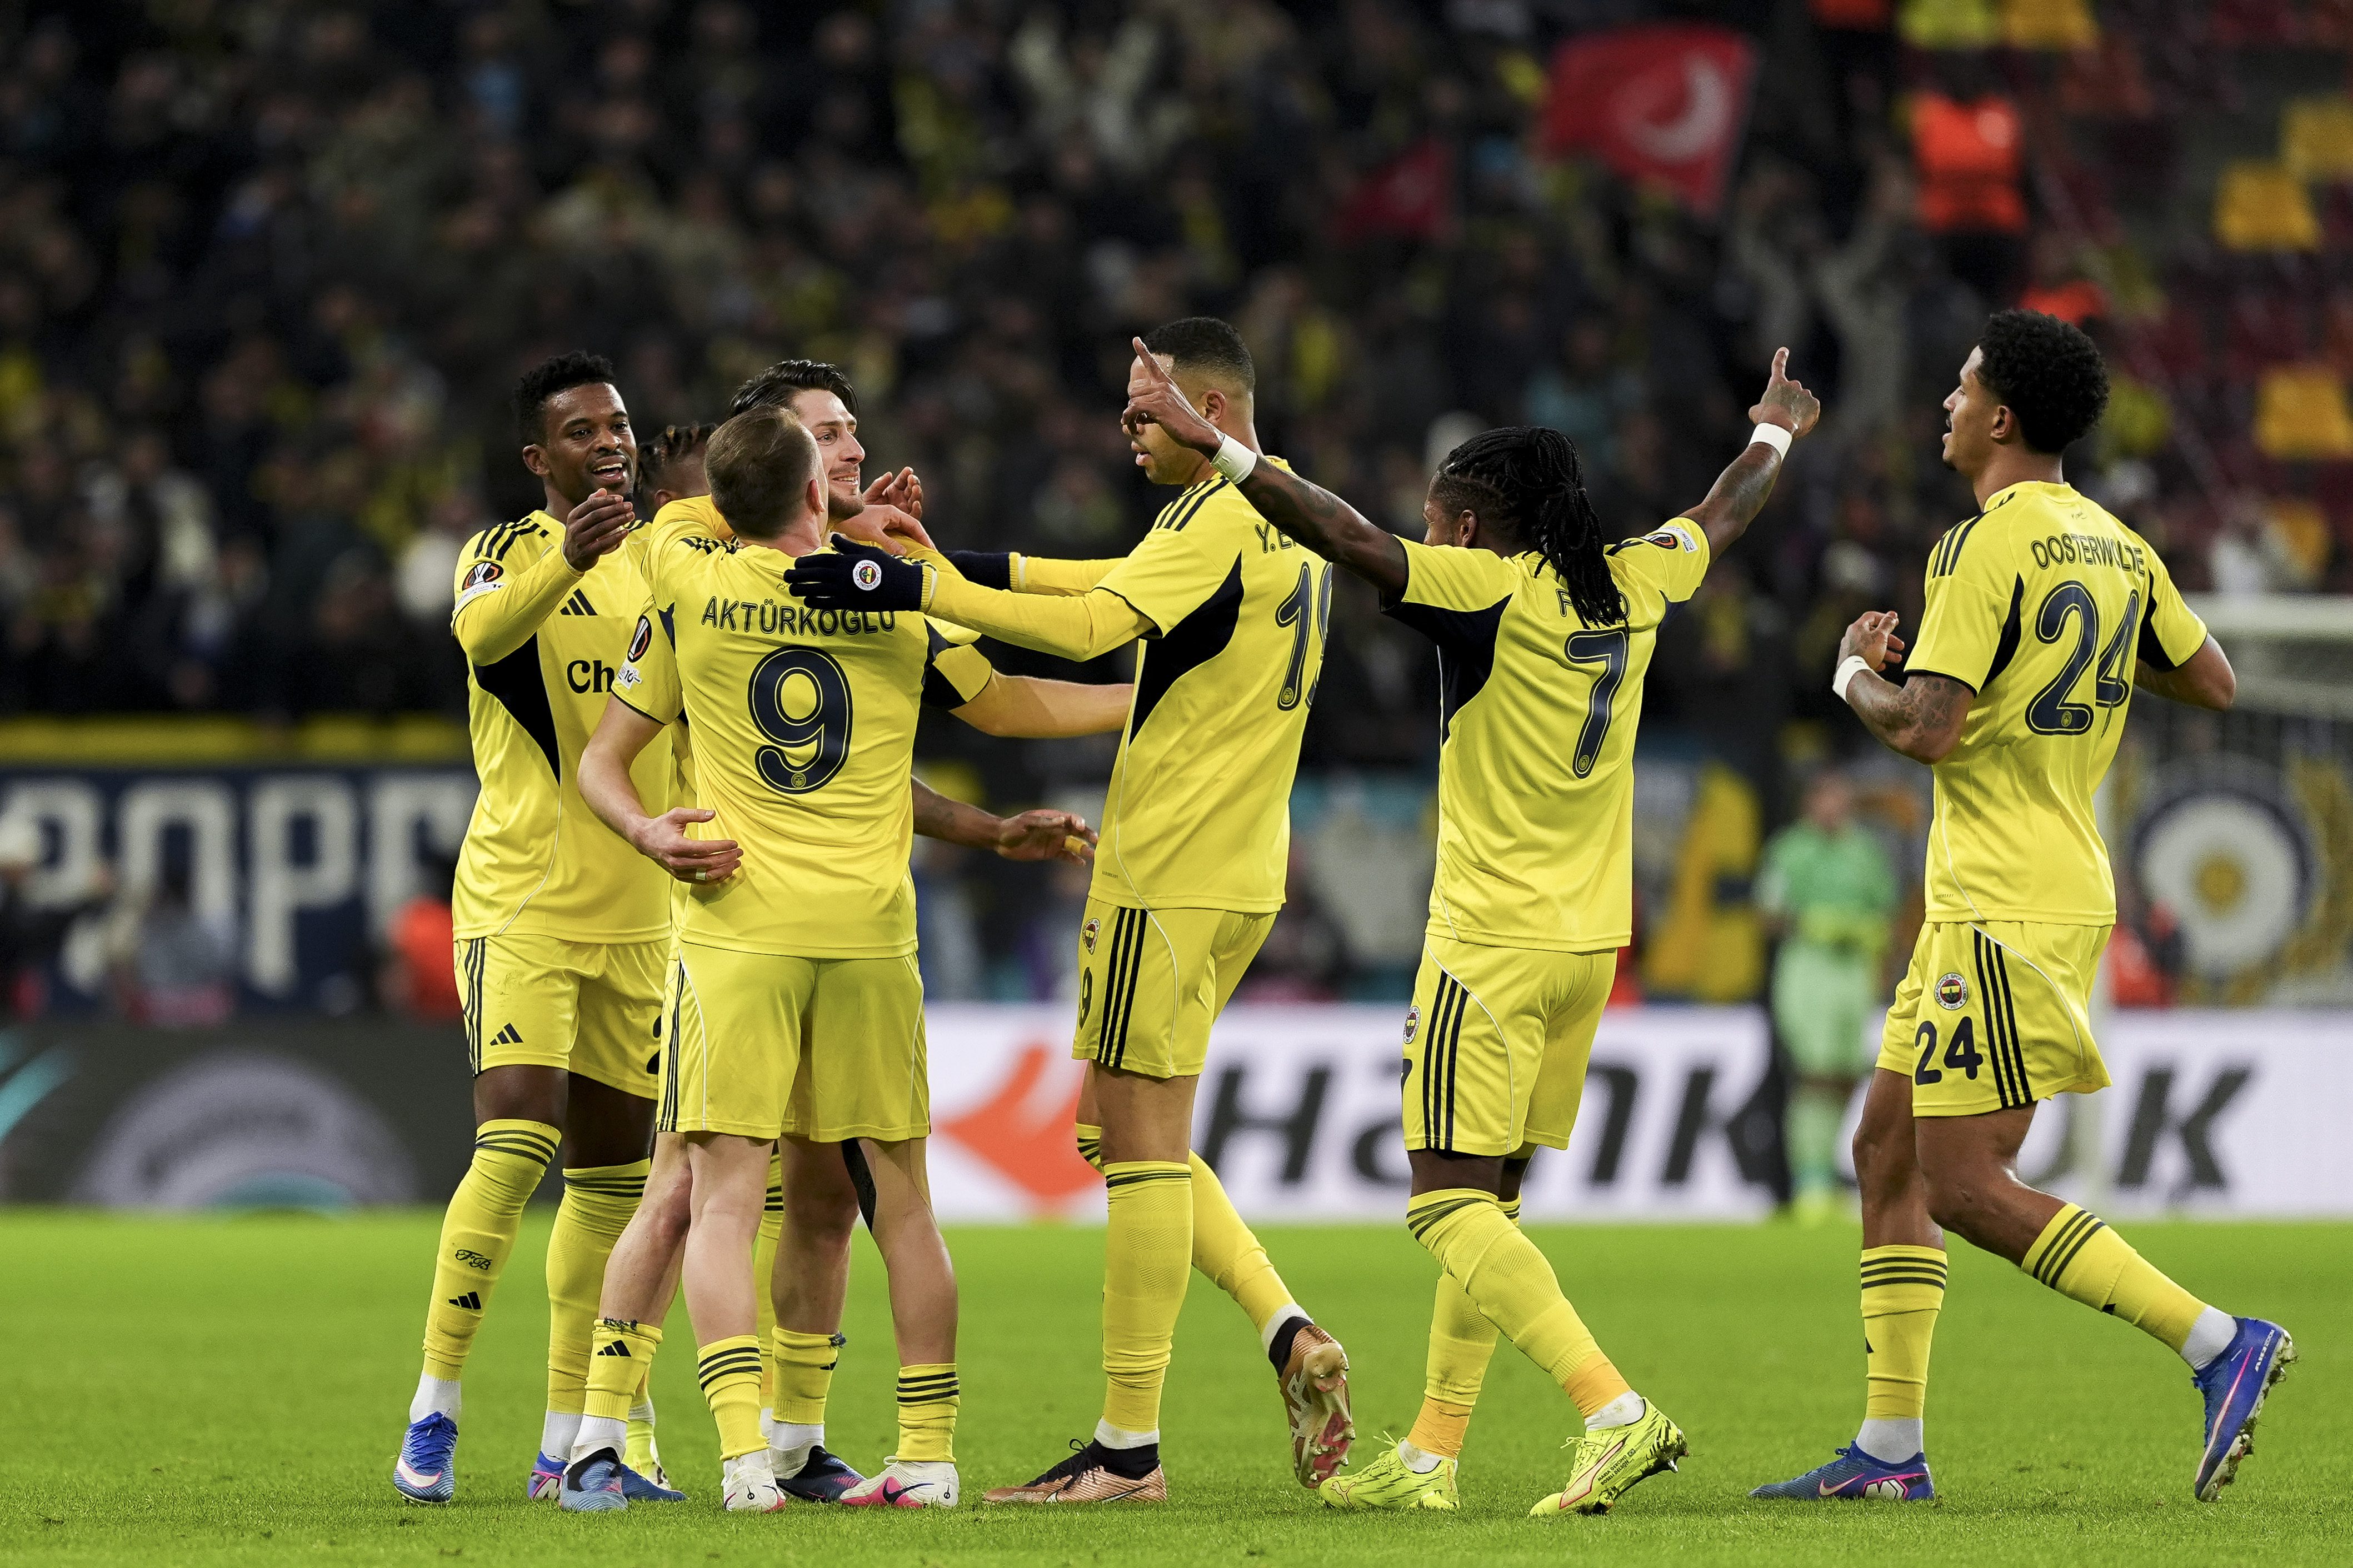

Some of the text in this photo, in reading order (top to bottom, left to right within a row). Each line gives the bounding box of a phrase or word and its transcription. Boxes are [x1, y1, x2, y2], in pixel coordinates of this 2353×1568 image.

[1565, 627, 1629, 779] 7
[2025, 580, 2139, 739] 24
[748, 645, 853, 794] 9
[1915, 1016, 1984, 1086] 24
[1597, 1470, 1611, 1481] MARIA
[1601, 1473, 1615, 1485] ROSELI
